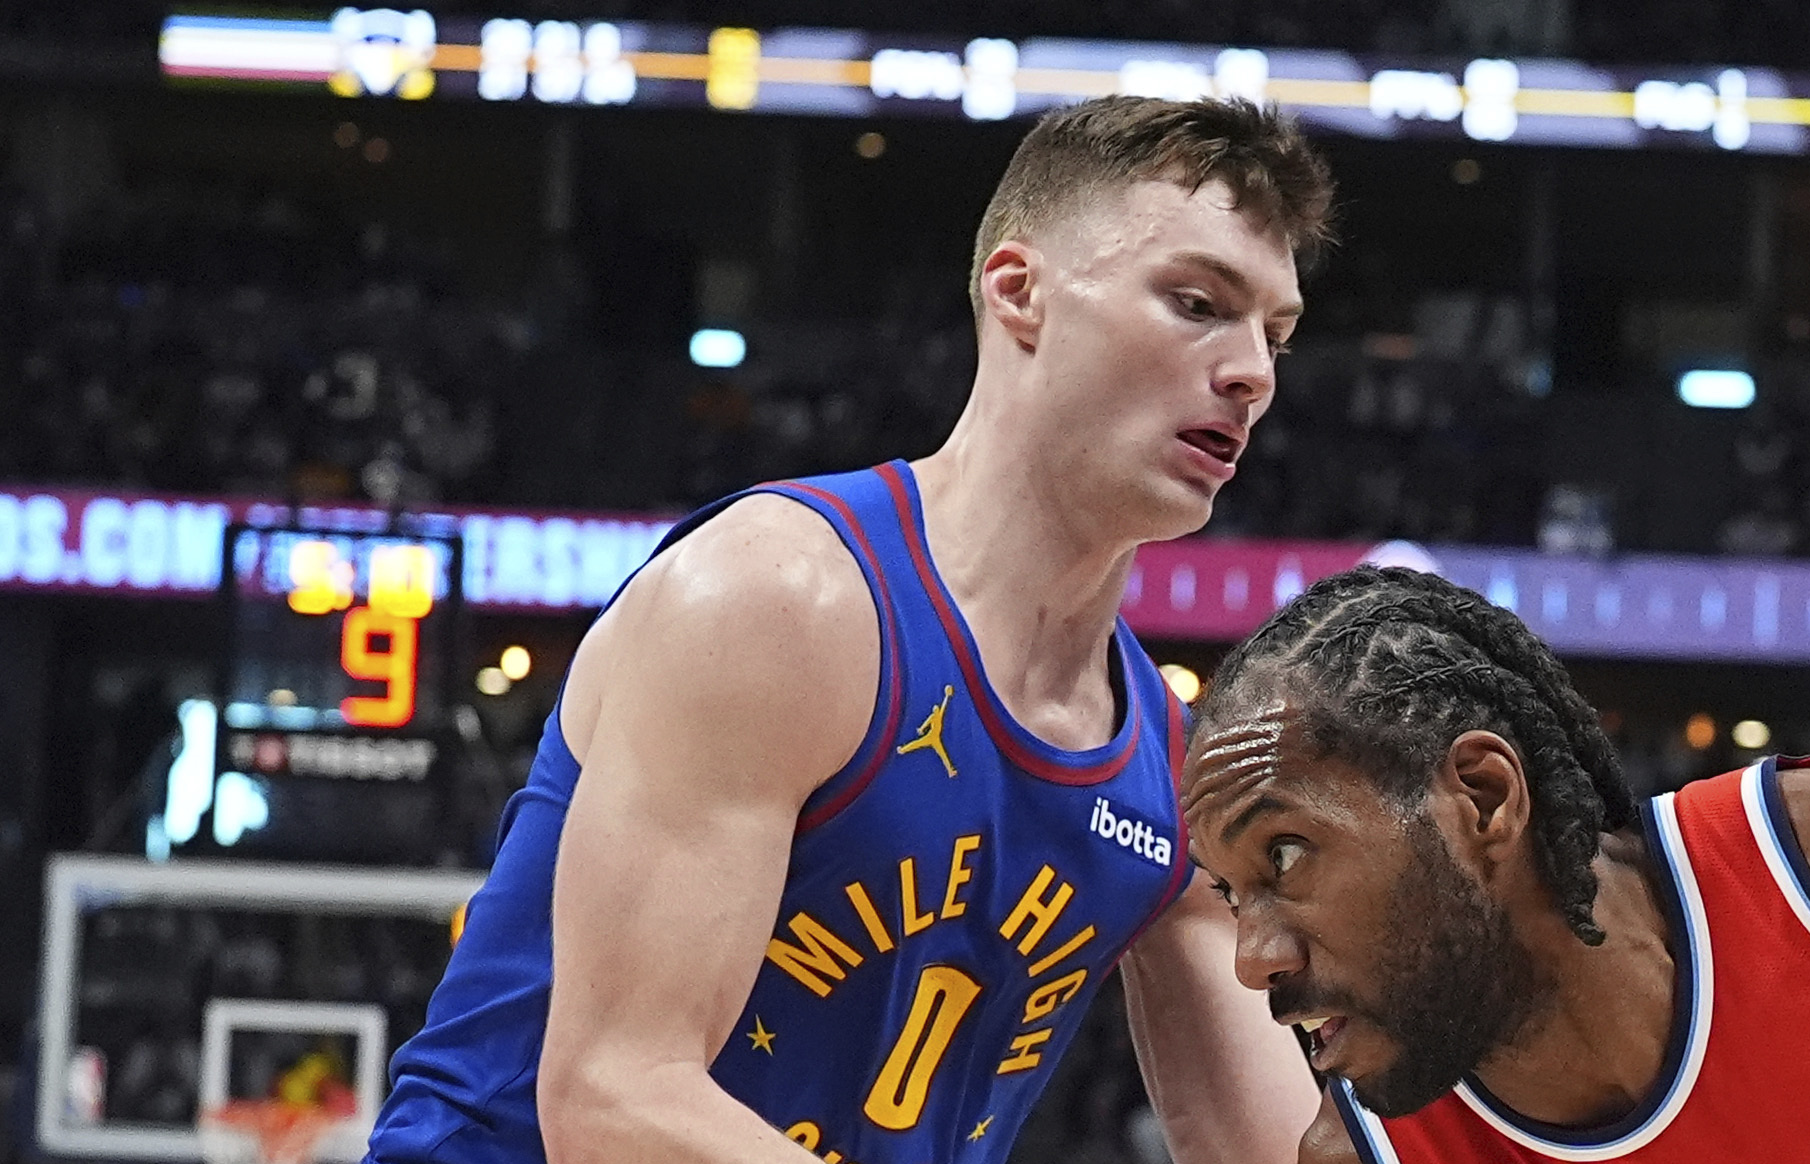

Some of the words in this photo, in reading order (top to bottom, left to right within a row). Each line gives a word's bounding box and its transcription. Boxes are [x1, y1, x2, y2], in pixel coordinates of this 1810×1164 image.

[340, 606, 420, 727] 9
[1090, 797, 1172, 866] ibotta
[765, 834, 982, 998] MILE
[997, 864, 1097, 1075] HIGH
[863, 965, 983, 1131] 0
